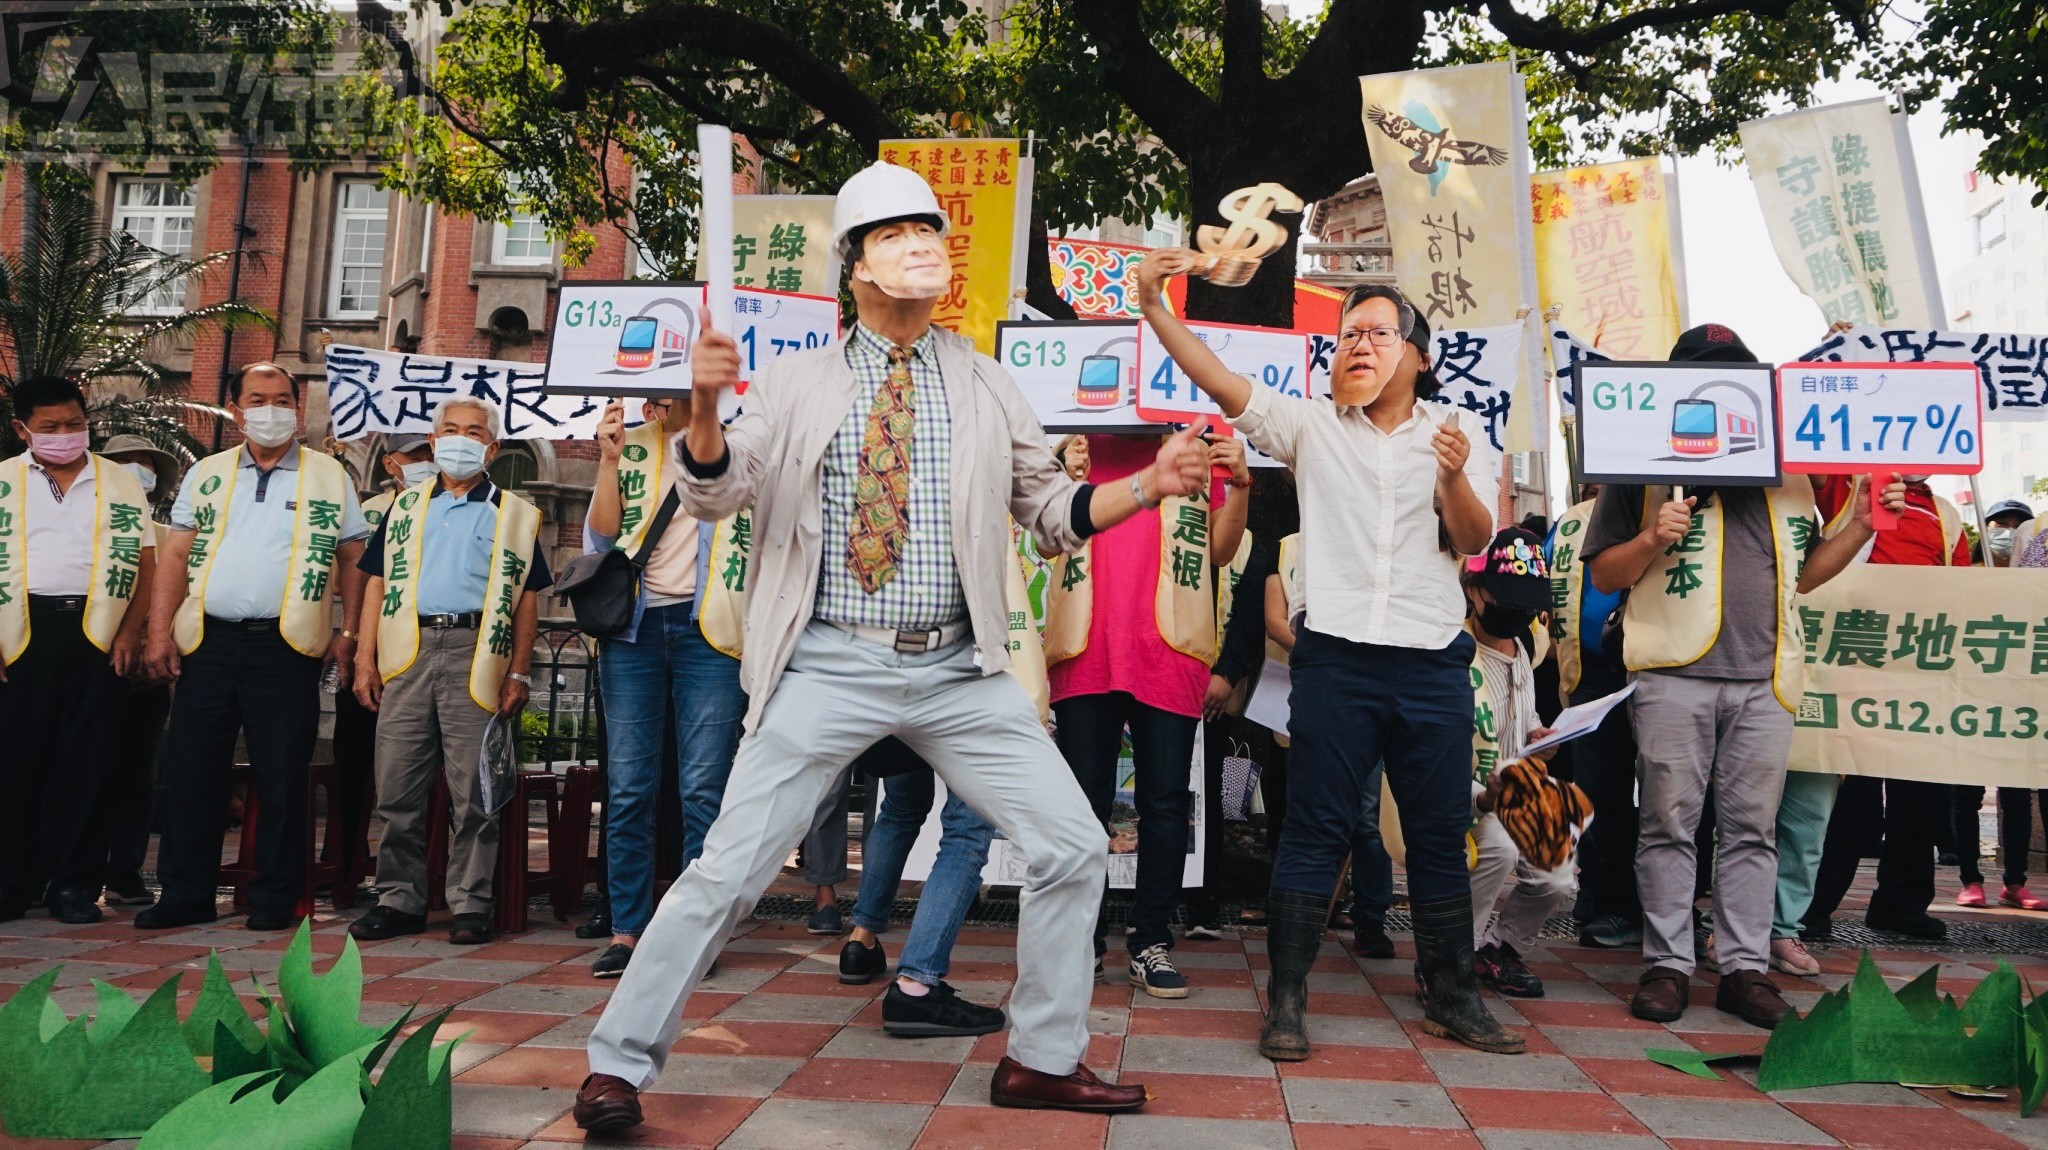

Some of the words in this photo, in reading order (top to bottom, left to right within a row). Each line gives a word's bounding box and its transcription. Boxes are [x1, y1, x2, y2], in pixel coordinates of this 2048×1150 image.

[911, 166, 1012, 186] 家園土地
[565, 300, 622, 328] G13a
[1010, 340, 1067, 367] G13
[1593, 381, 1656, 411] G12
[1801, 375, 1859, 394] 自償率
[1795, 403, 1974, 455] 41.77%
[104, 503, 144, 601] 家是根
[300, 499, 341, 602] 家是根
[1172, 488, 1210, 591] 是根
[488, 549, 526, 659] 家是根
